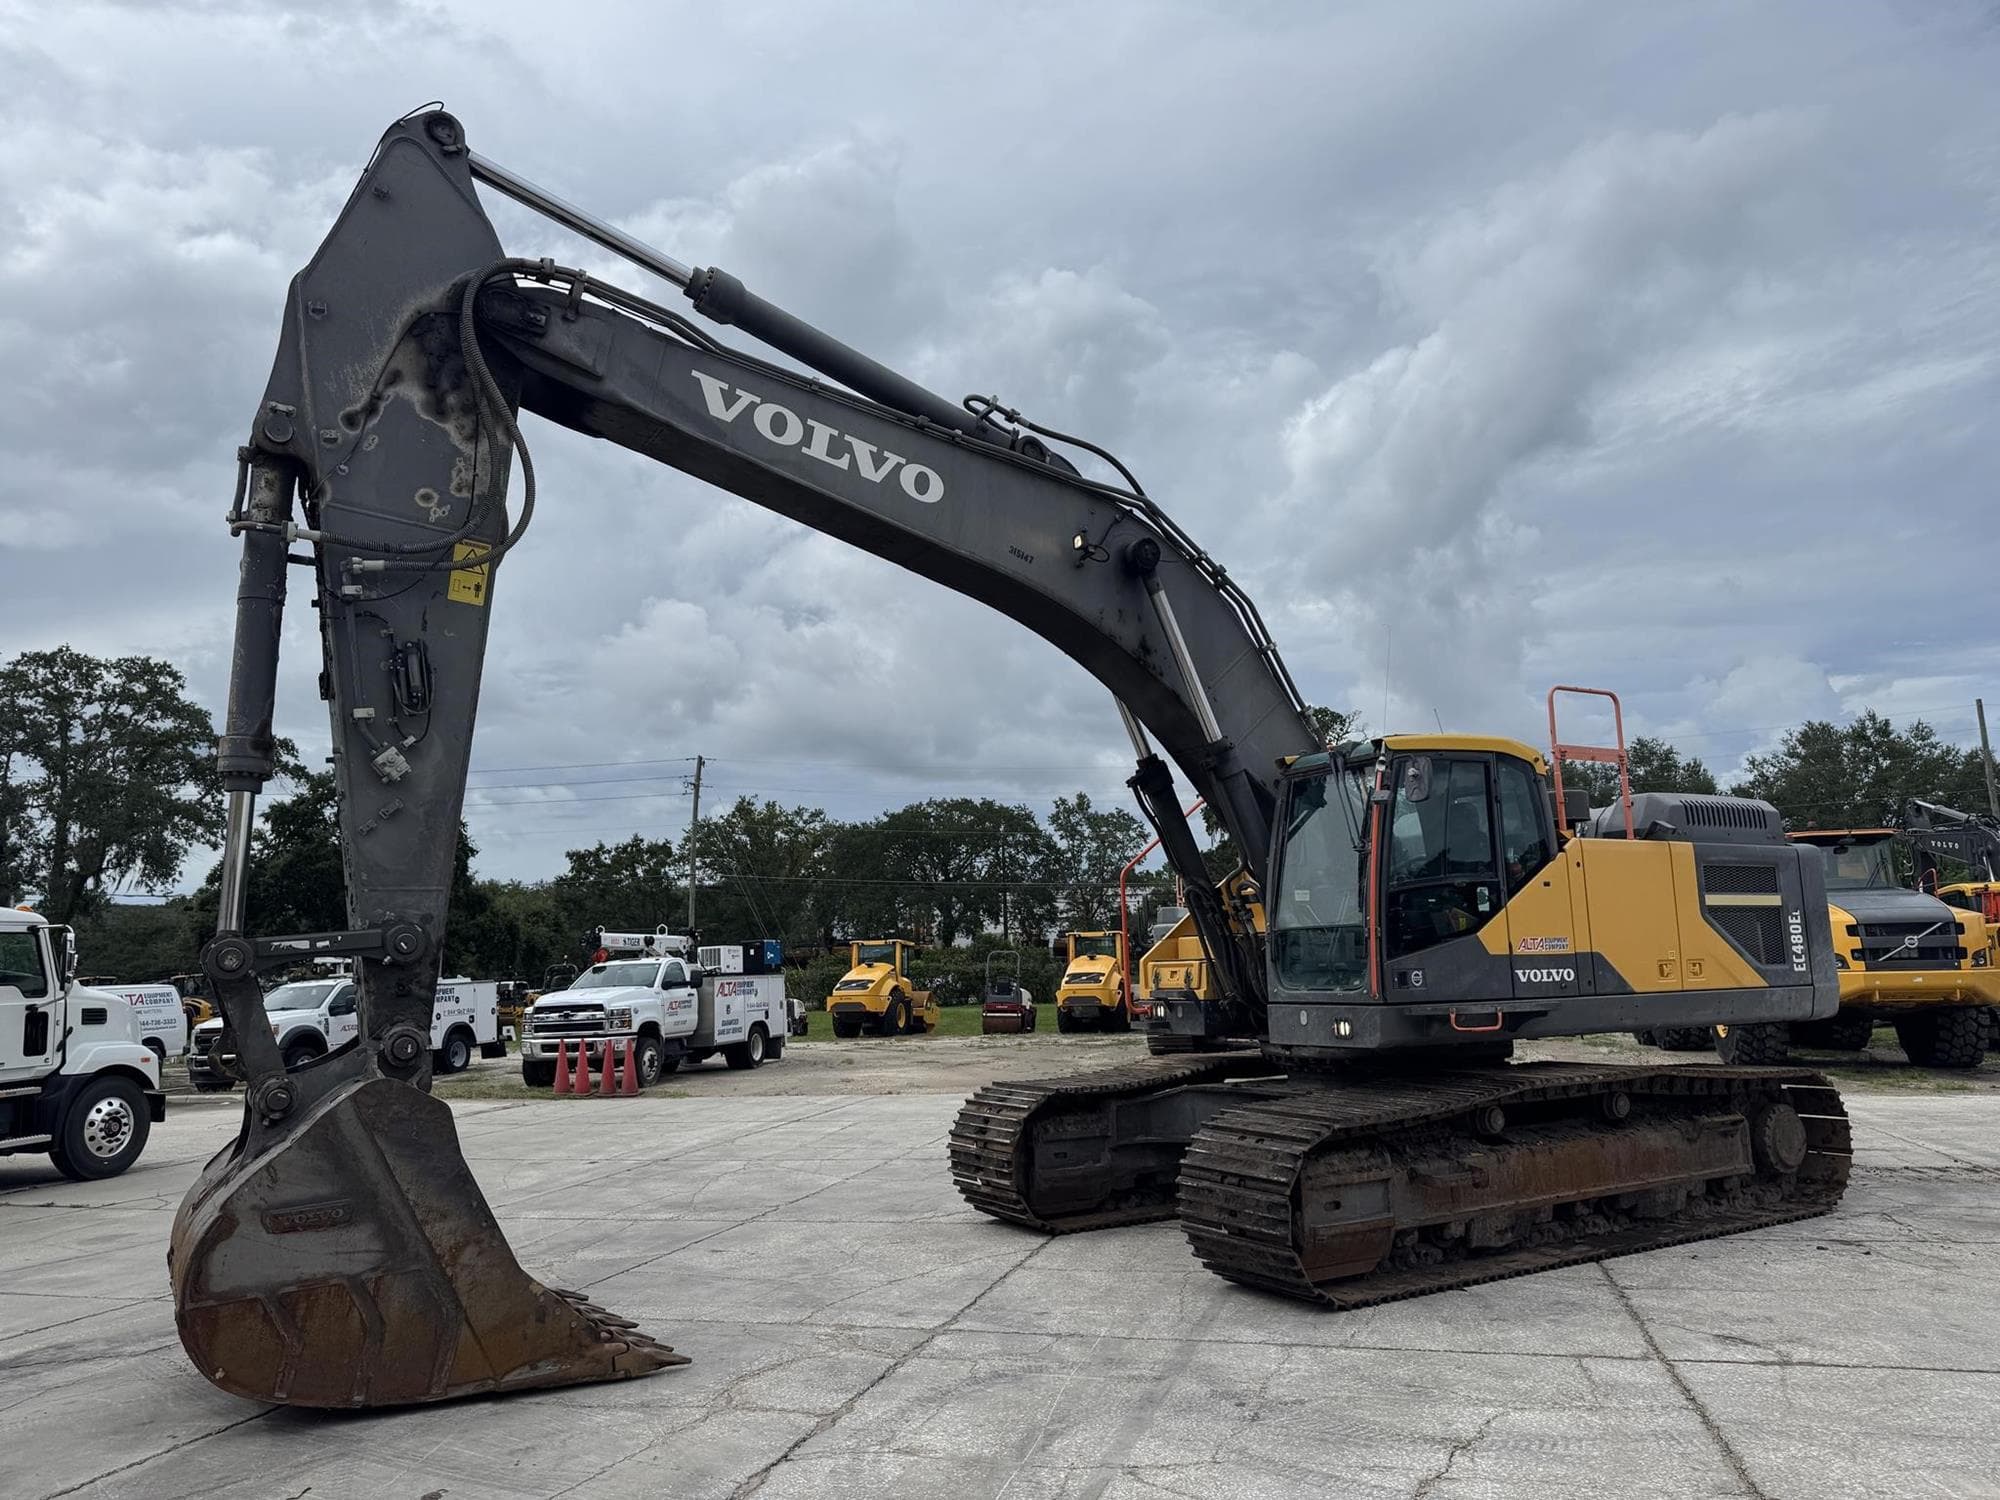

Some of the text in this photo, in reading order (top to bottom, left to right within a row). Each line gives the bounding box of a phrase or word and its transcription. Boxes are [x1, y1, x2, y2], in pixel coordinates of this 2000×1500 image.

[691, 369, 945, 503] VOLVO
[1930, 840, 1960, 849] VOLVO
[1518, 937, 1545, 951] ALTA
[1514, 968, 1575, 982] VOLVO
[716, 981, 737, 997] ALTA
